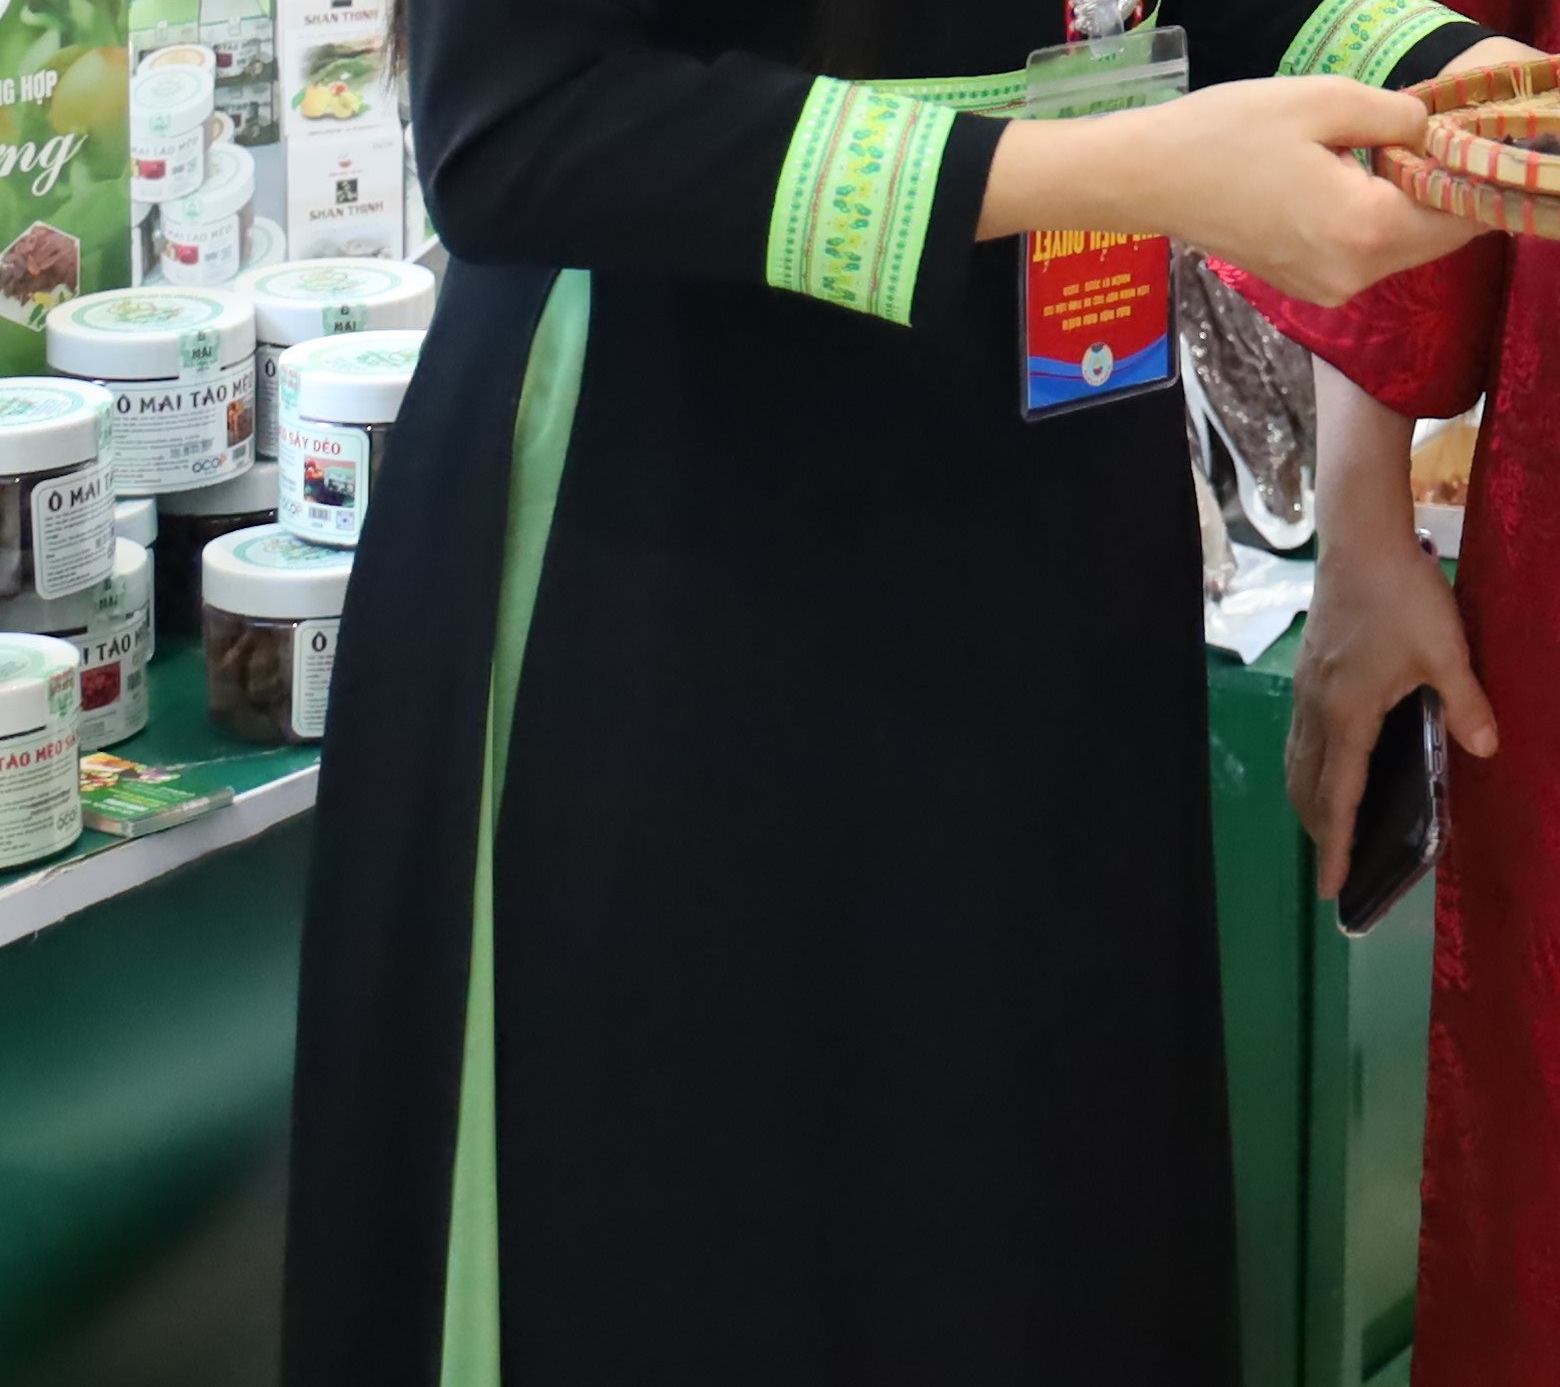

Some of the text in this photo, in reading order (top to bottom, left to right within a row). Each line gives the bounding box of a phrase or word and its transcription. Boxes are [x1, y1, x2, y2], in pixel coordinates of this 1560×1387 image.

[21, 70, 57, 104] HỢP
[309, 208, 344, 220] SHAN
[117, 393, 130, 413] Ô
[140, 395, 181, 414] MAI
[190, 386, 226, 409] TÁO
[192, 455, 227, 473] OCOP
[49, 482, 101, 512] Ô MAI
